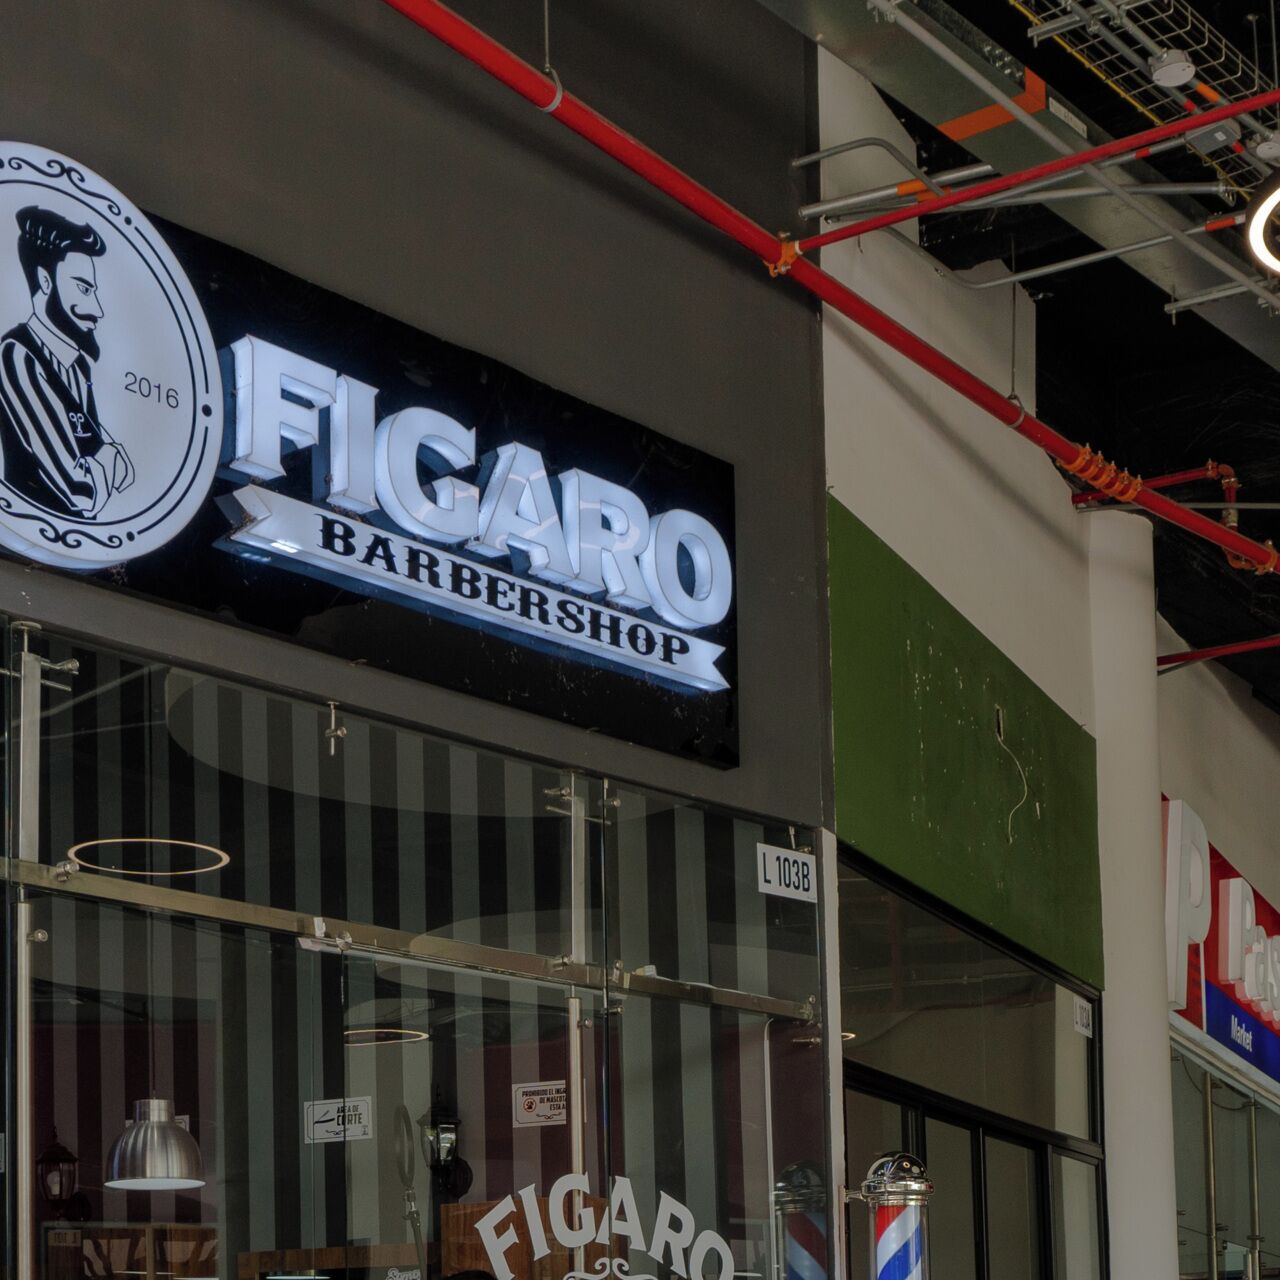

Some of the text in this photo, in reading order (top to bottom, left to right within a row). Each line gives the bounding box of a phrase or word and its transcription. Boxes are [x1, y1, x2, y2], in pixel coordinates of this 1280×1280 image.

[123, 371, 180, 410] 2016
[231, 334, 733, 631] FIGARO
[317, 513, 692, 669] BARBERSHOP
[763, 852, 810, 893] L 103B
[1230, 1015, 1254, 1053] Market
